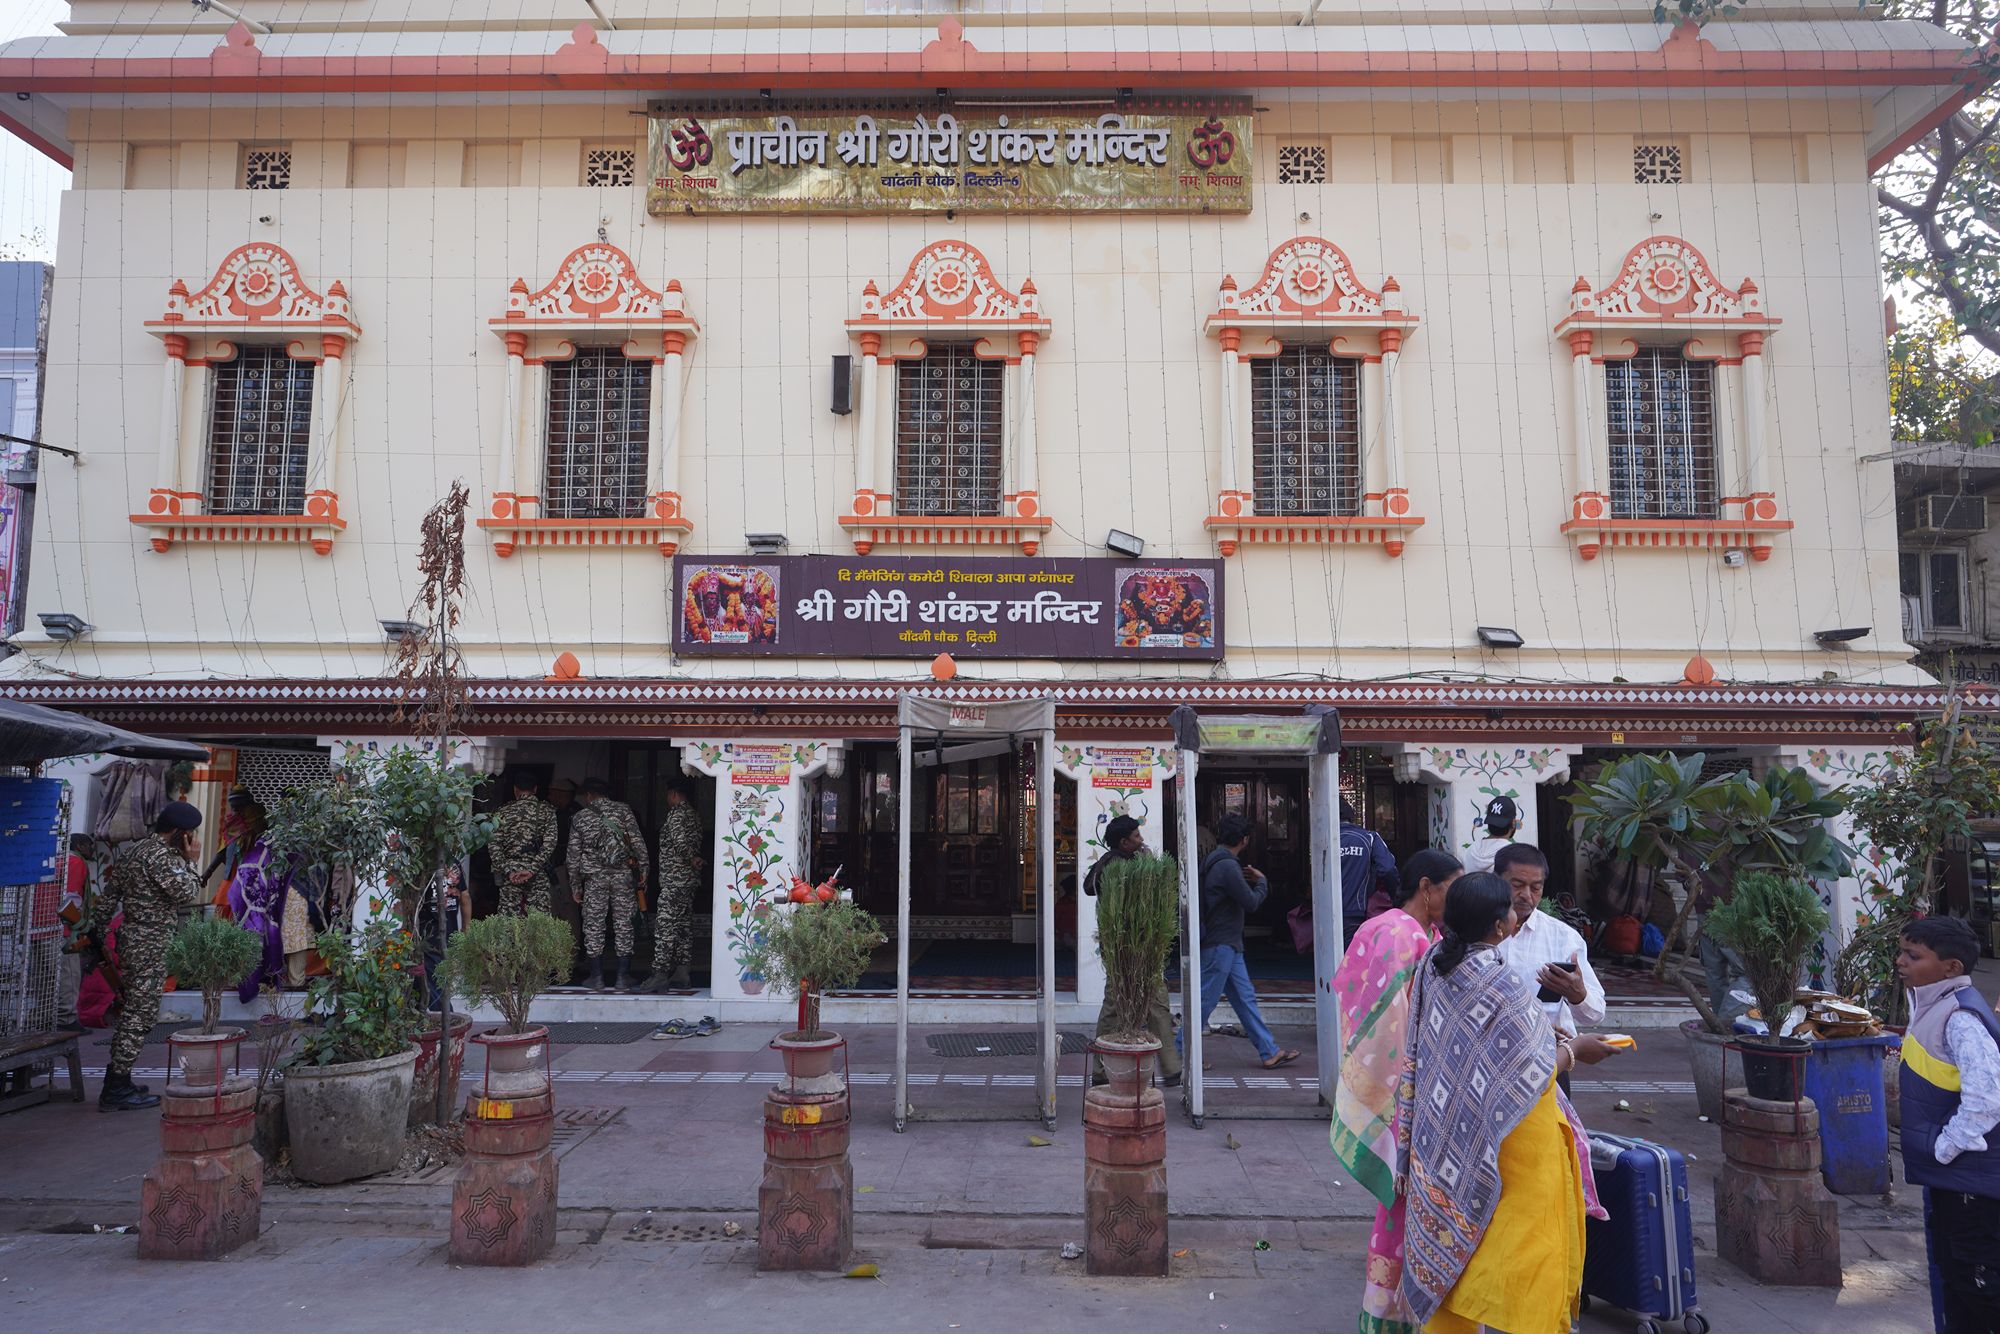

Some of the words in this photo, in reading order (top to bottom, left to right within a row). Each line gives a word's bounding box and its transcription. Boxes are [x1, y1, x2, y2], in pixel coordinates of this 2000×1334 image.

[726, 115, 828, 177] प्राचीन
[835, 114, 880, 167] श्री
[887, 113, 961, 167] गौरी
[968, 114, 1058, 166] शंकर
[1065, 113, 1171, 166] मन्दिर
[881, 172, 922, 187] चांदनी
[838, 569, 852, 582] दि
[908, 569, 944, 583] कमेटी
[949, 569, 993, 583] शिवाला
[996, 573, 1026, 583] आपा
[1028, 571, 1075, 584] गंगाधर
[795, 589, 836, 622] श्री
[843, 588, 910, 623] गौरी
[918, 591, 1001, 623] शंकर
[1006, 590, 1103, 623] मन्दिर
[934, 629, 959, 642] चौक
[966, 629, 997, 643] दिल्ली
[951, 706, 985, 721] MALE
